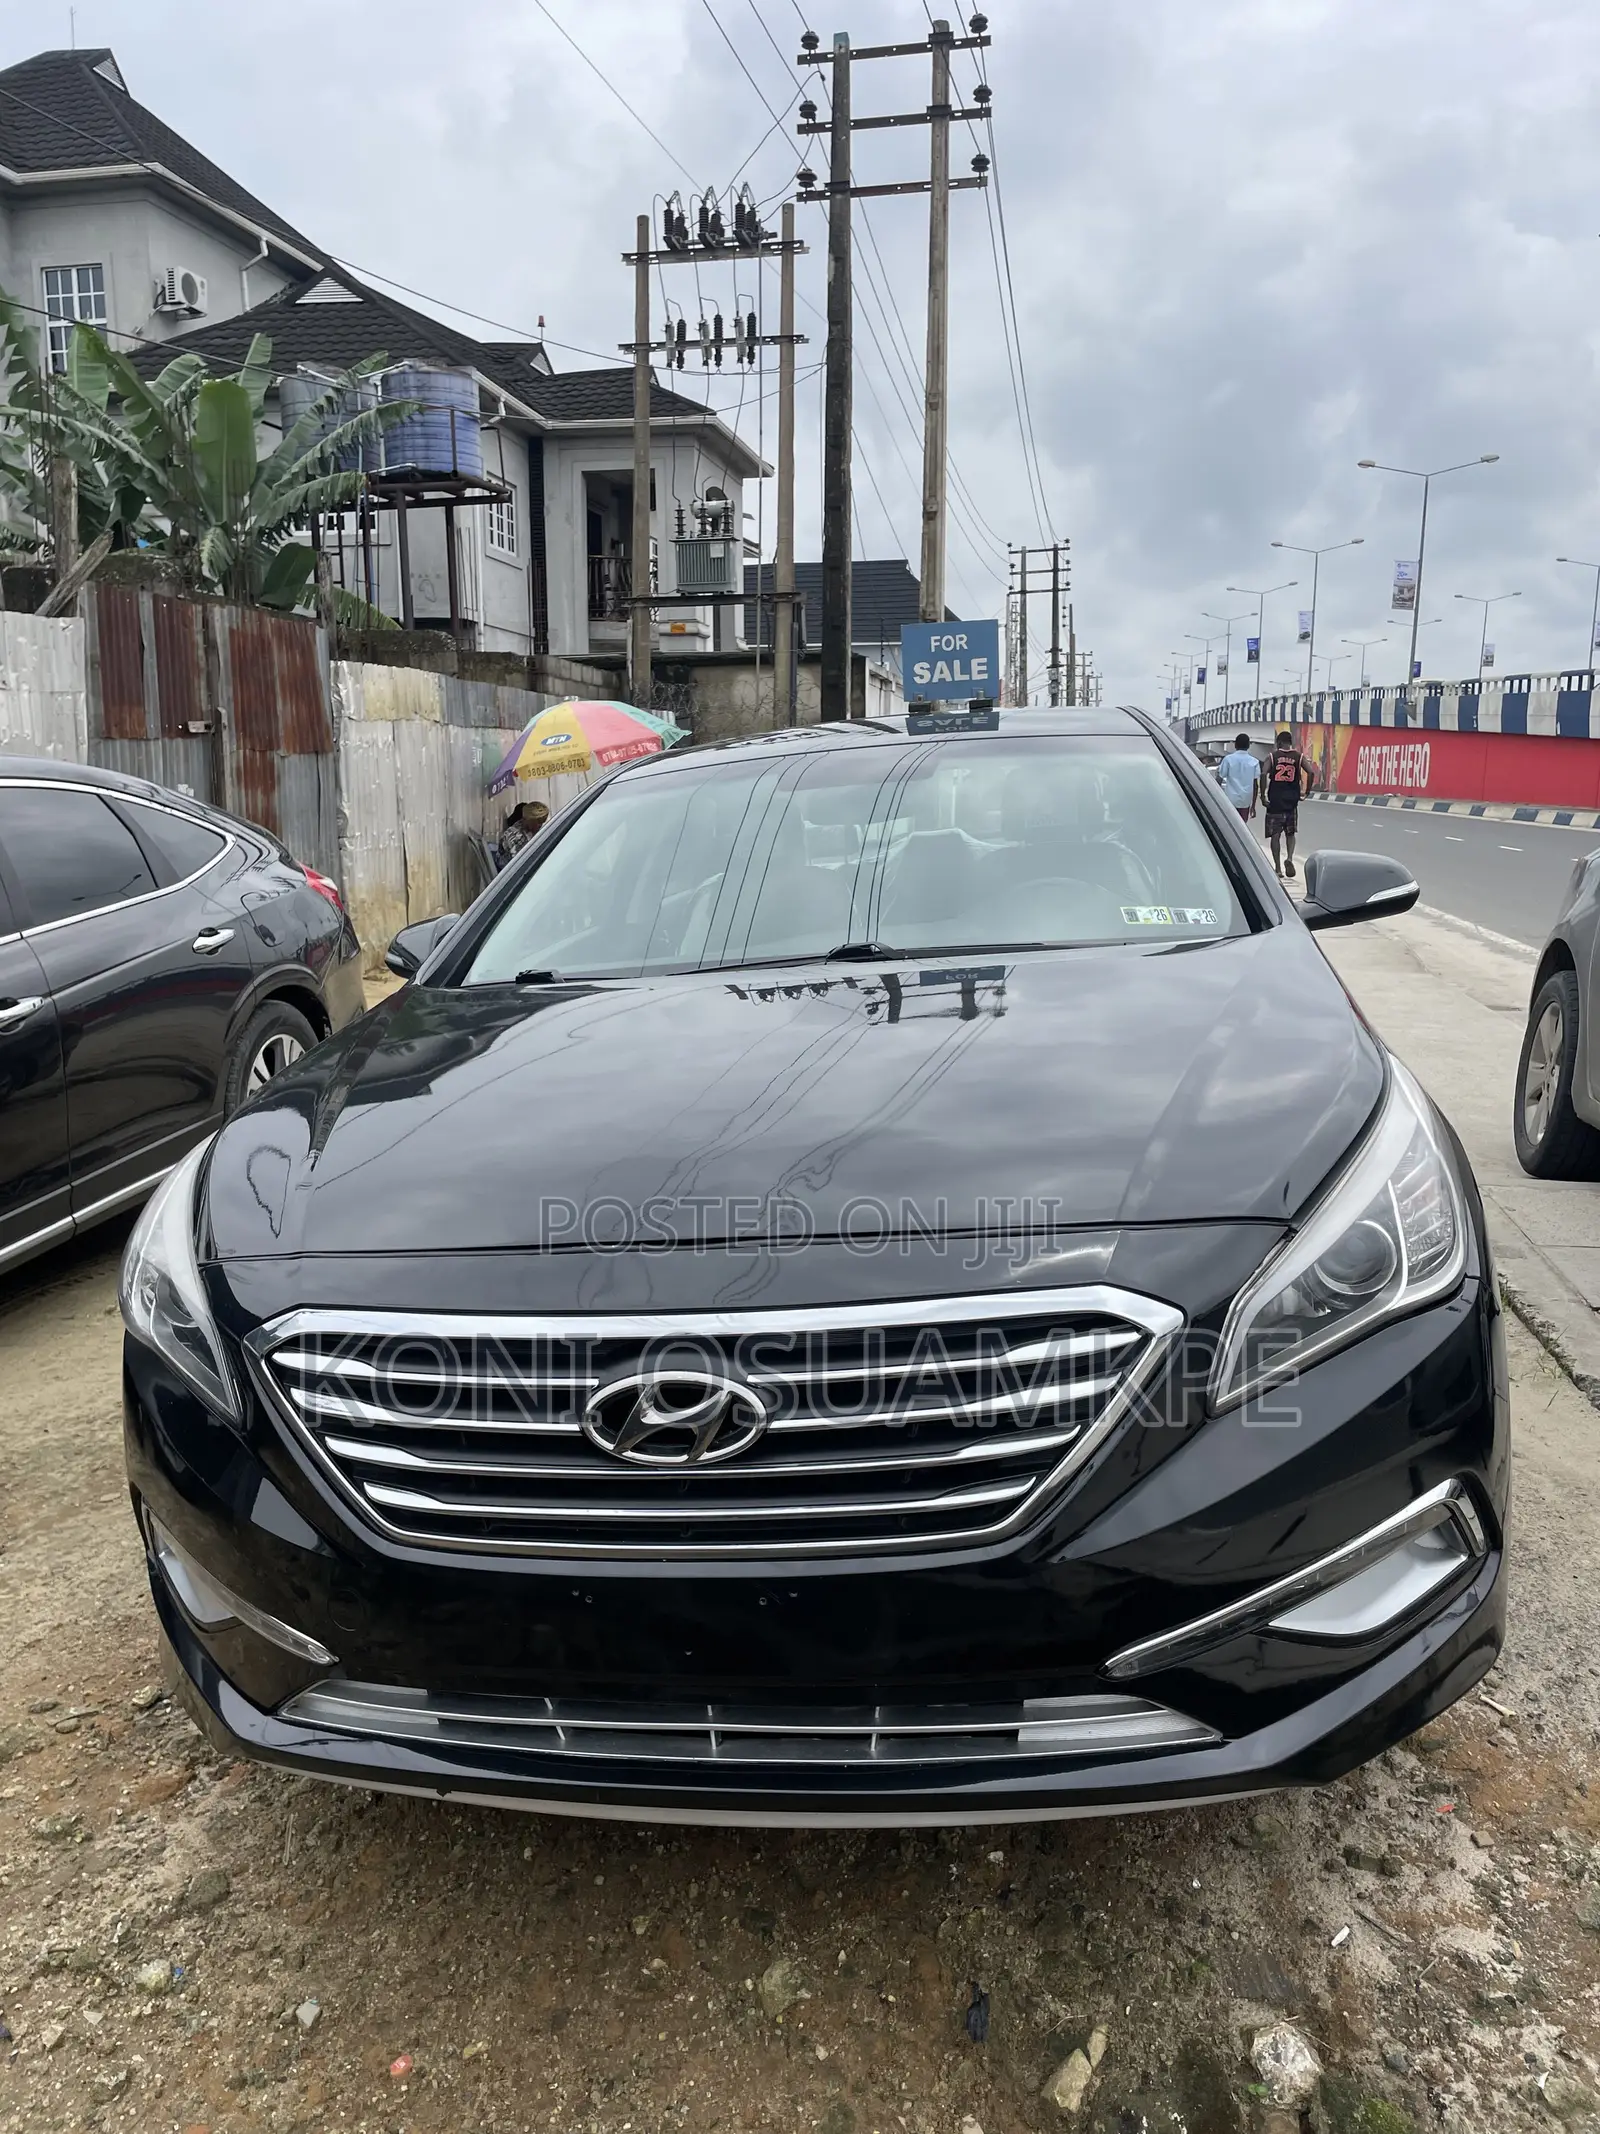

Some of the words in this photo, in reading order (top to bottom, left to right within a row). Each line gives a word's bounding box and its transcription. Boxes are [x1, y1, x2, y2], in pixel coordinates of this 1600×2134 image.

[930, 634, 968, 652] FOR
[913, 657, 989, 684] SALE
[546, 734, 568, 746] MTN
[1275, 765, 1296, 782] 23
[1357, 745, 1370, 785] GO
[1369, 745, 1382, 785] BE
[1381, 745, 1400, 786] THE
[1399, 742, 1431, 788] HERO
[1154, 908, 1169, 921] 26
[1203, 909, 1217, 923] 26
